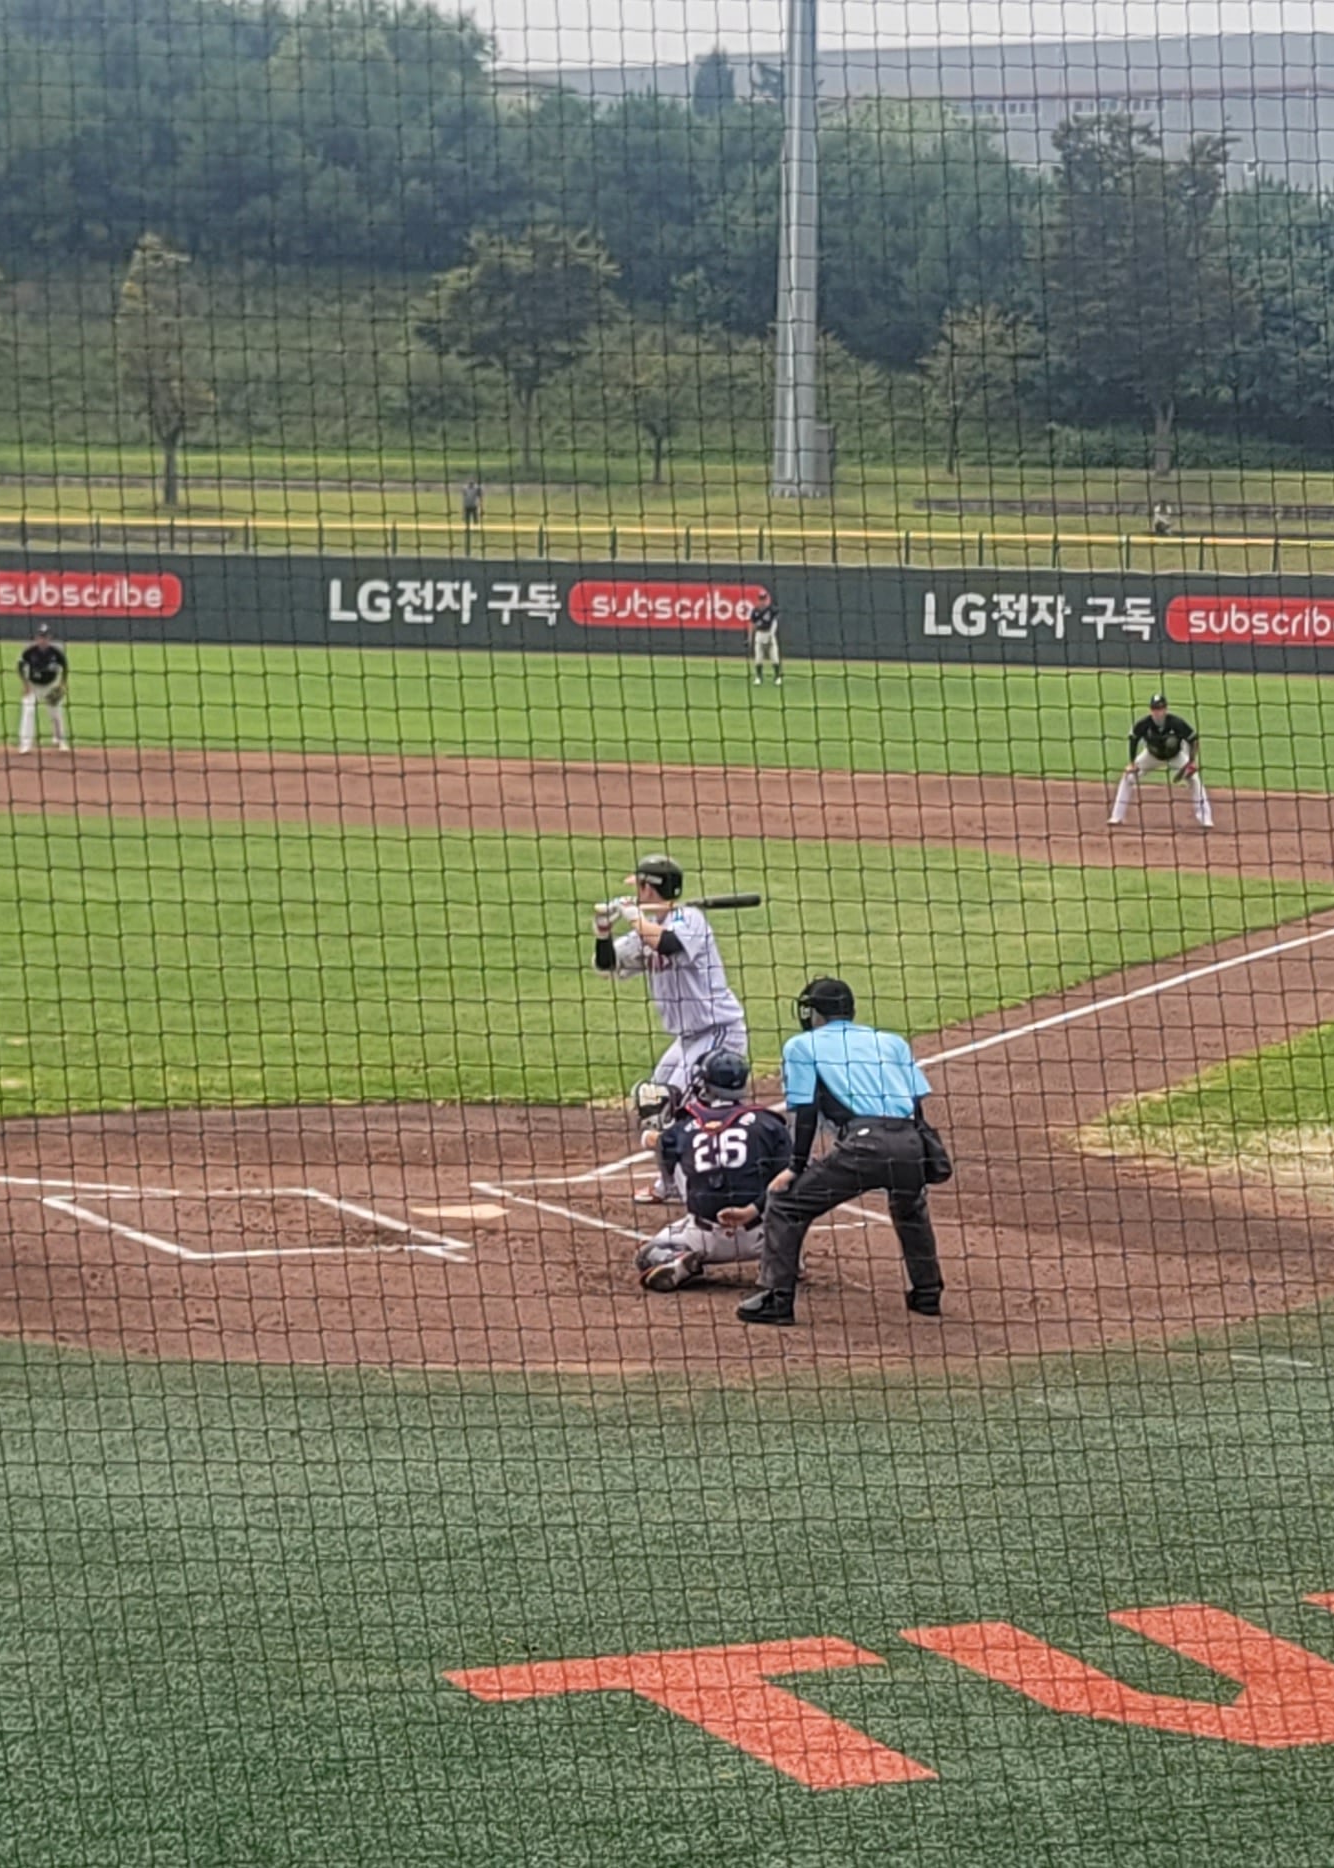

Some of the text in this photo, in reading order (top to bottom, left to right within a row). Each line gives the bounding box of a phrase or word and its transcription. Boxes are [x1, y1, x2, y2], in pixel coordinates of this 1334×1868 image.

[329, 580, 754, 626] LG전자 구독 subscribe
[924, 592, 1071, 638] LG전자
[1081, 597, 1155, 640] 구독
[692, 1128, 747, 1172] 26
